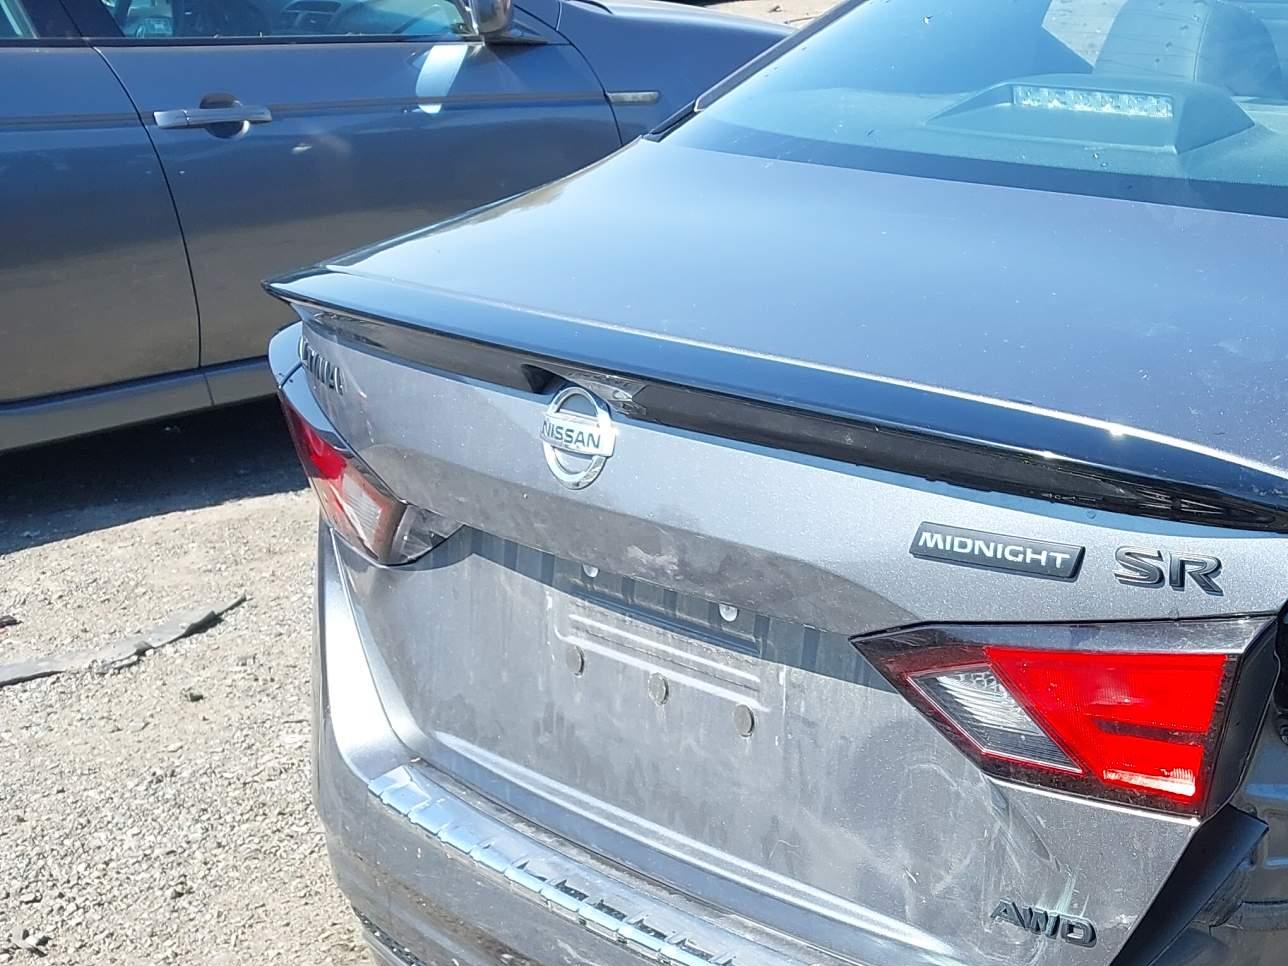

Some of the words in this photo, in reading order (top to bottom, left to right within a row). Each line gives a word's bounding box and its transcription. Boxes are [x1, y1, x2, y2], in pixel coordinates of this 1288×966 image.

[542, 419, 601, 449] NISSAN
[918, 531, 1071, 570] MIDNIGHT
[1113, 545, 1224, 597] SR
[990, 897, 1097, 949] AWD
